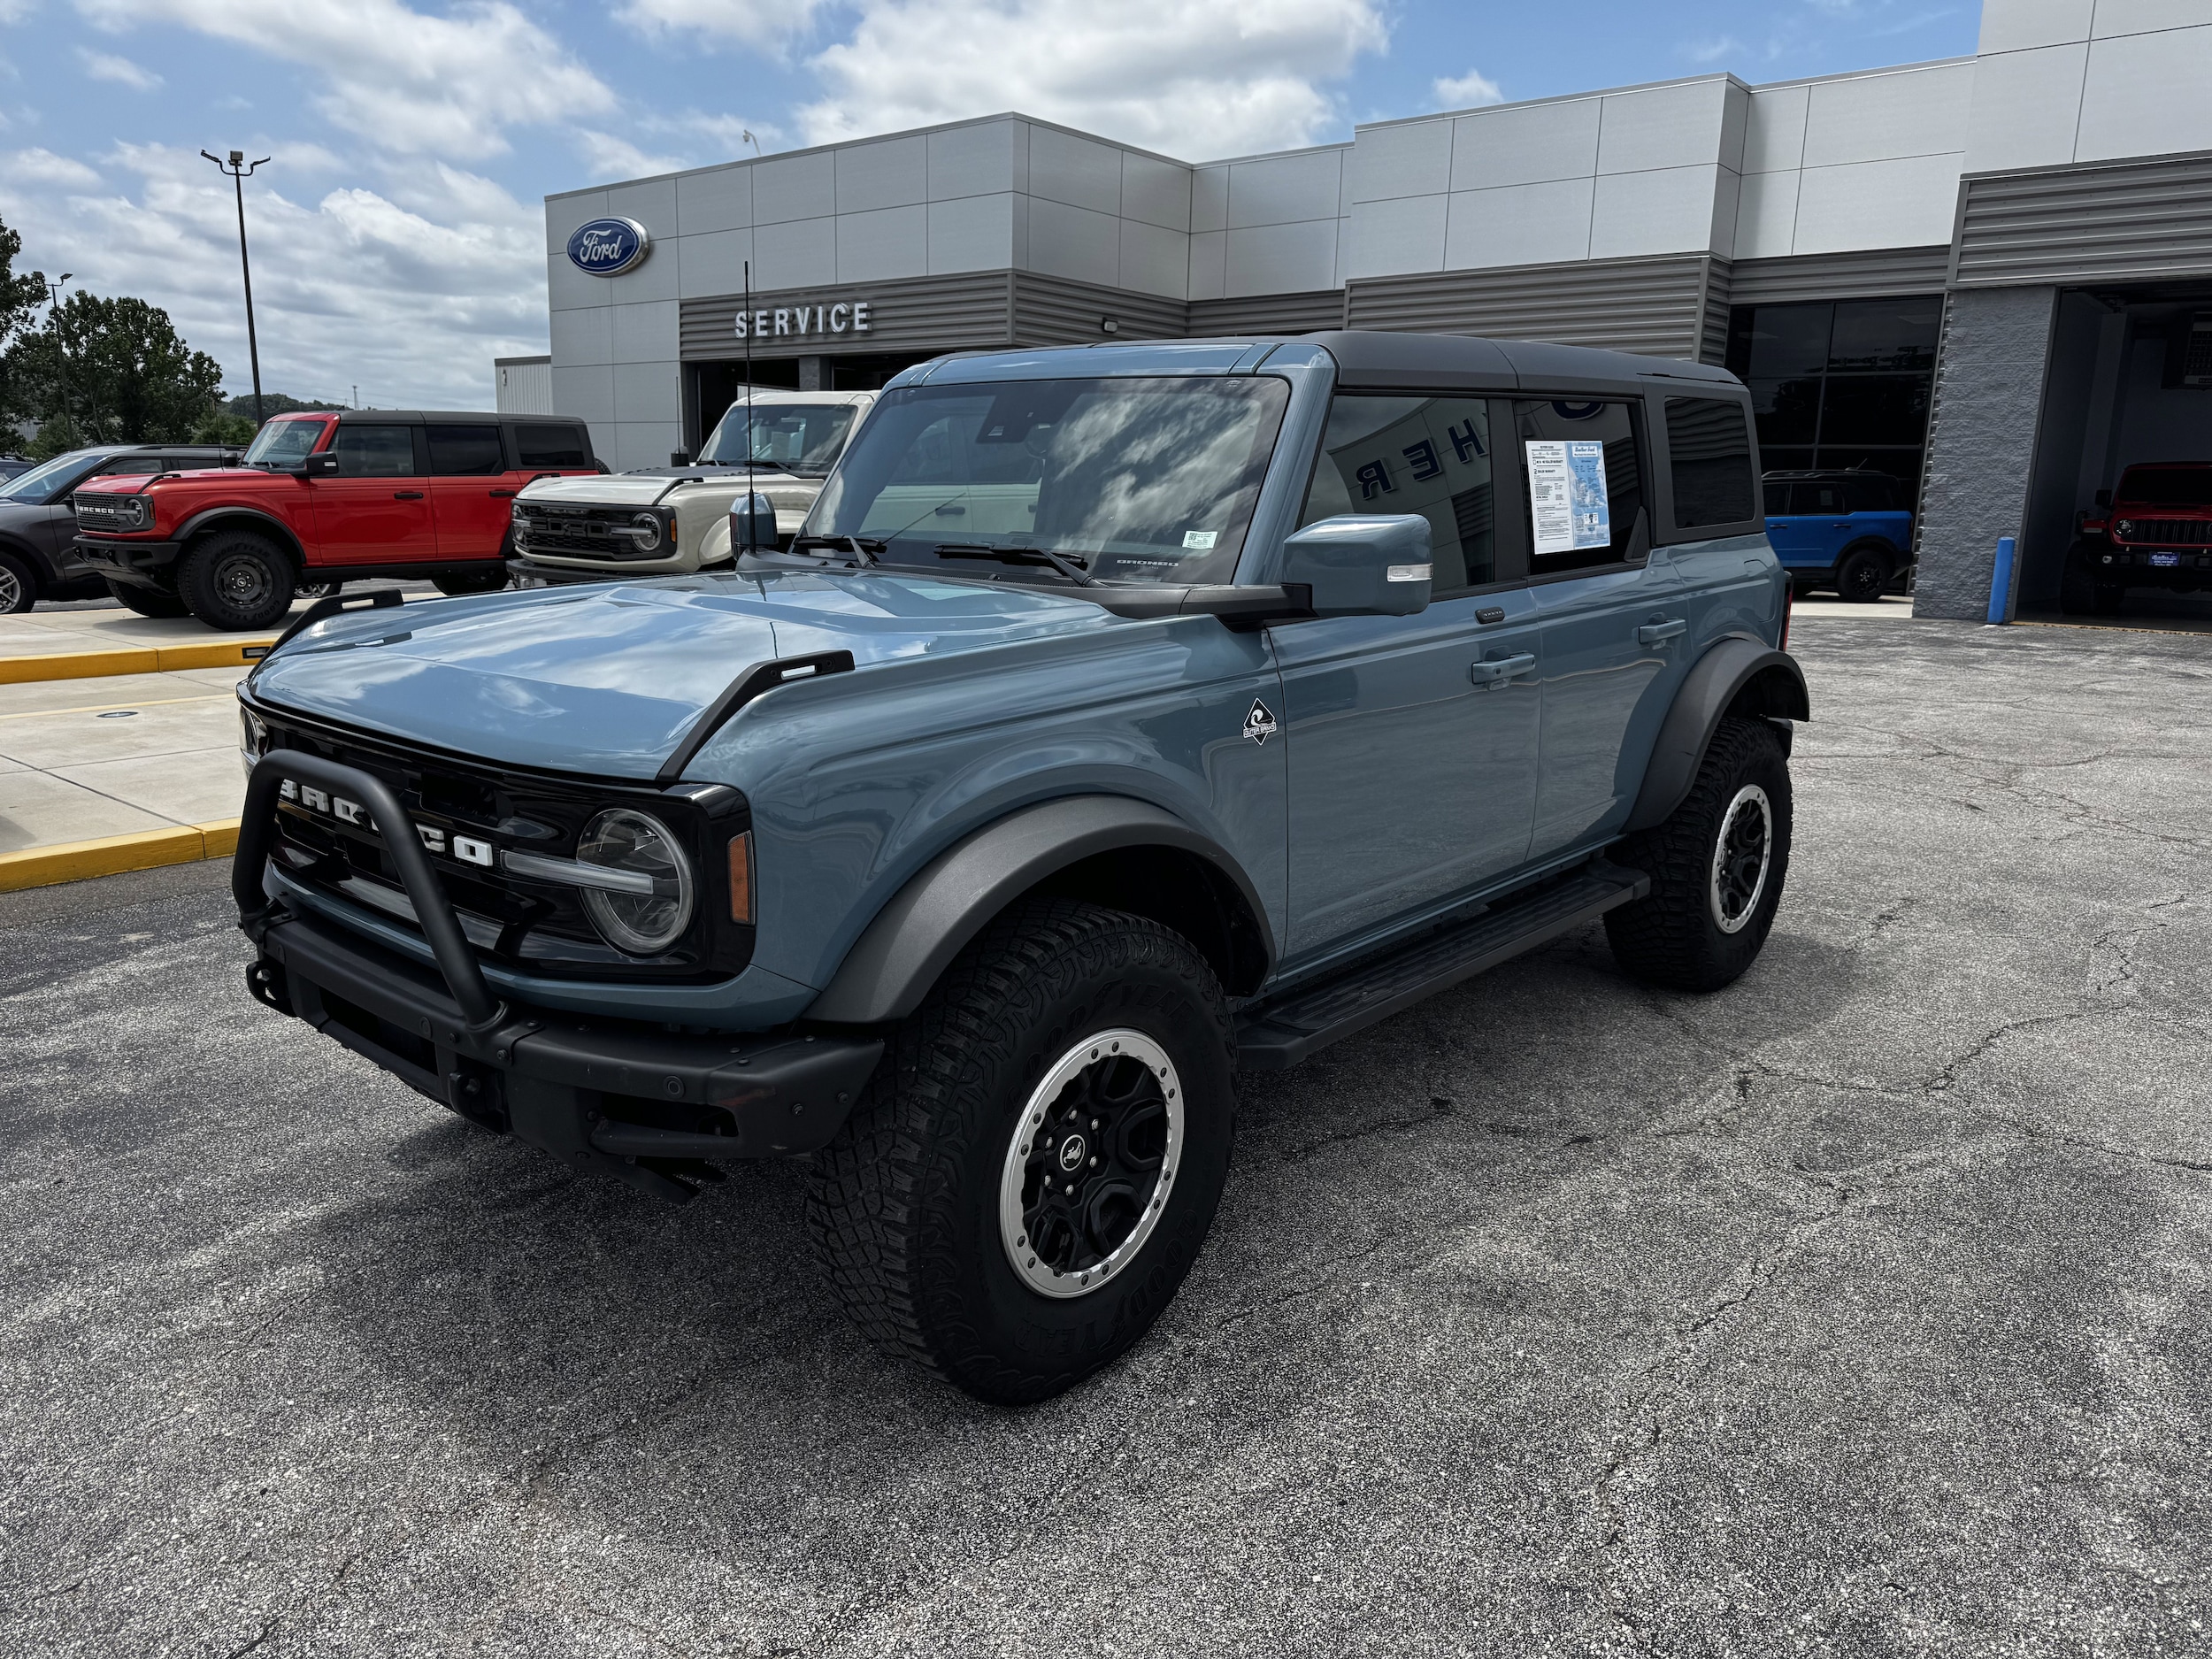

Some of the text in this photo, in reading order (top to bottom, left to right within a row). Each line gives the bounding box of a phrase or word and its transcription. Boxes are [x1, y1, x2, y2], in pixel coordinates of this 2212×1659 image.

[580, 229, 623, 263] Ford
[735, 302, 869, 339] SERVICE
[1244, 724, 1275, 736] OUTER BANKS
[280, 778, 494, 867] BROCO
